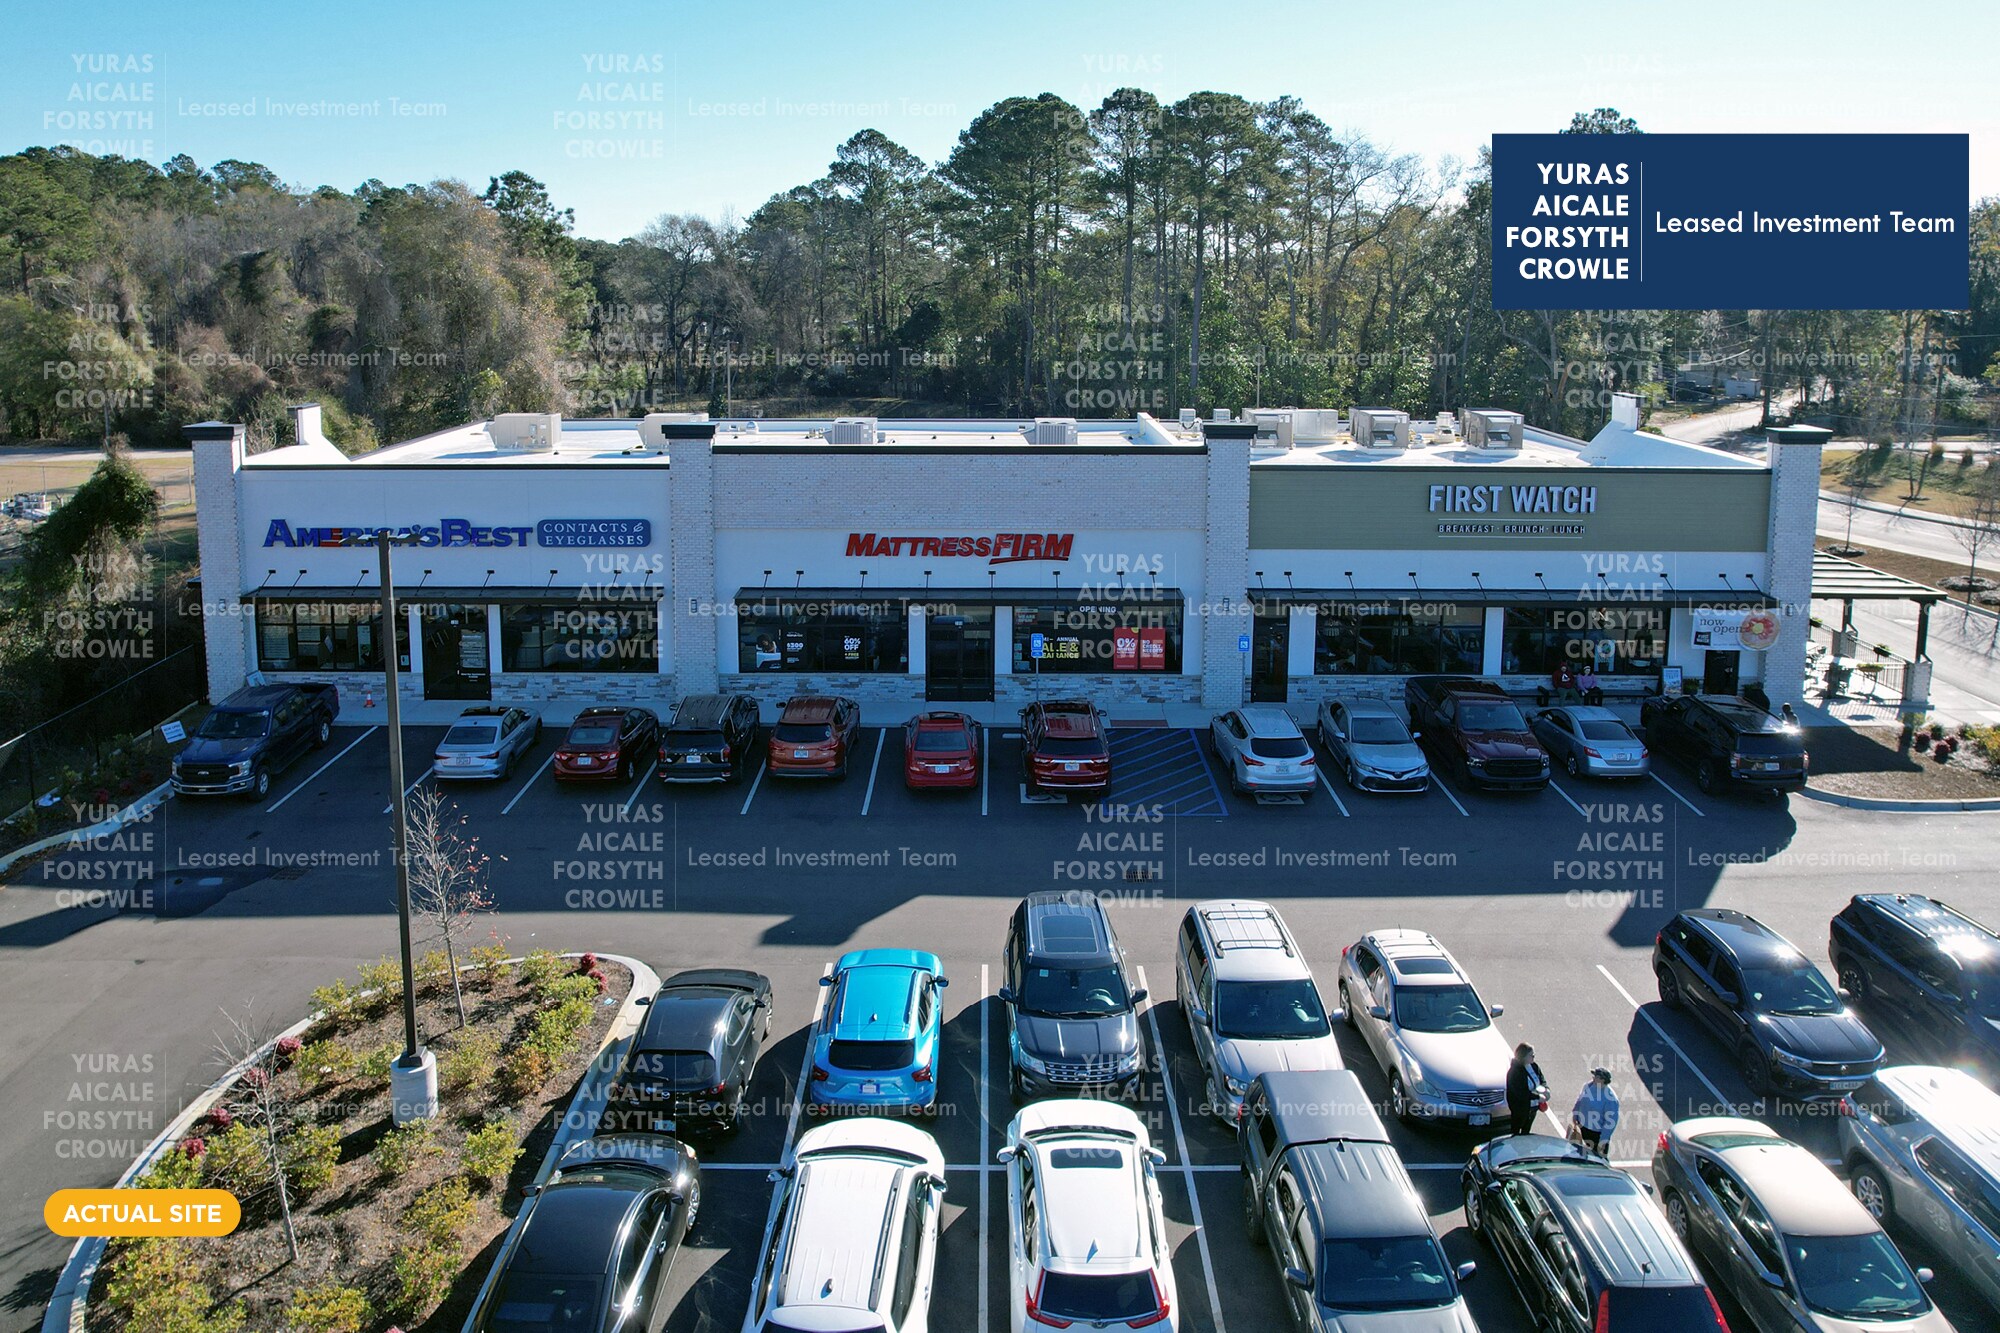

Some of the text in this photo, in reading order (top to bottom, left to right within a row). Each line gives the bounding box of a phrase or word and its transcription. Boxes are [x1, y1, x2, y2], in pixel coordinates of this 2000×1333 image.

[1428, 485, 1597, 514] FIRST WATCH
[543, 522, 628, 533] CONTACTS
[1438, 524, 1586, 534] BREAKFAST BRUNCH LUNCH
[545, 535, 644, 545] EYEGLASSES
[1079, 605, 1117, 613] OPENING
[1699, 618, 1725, 626] now
[1713, 625, 1742, 635] open
[843, 637, 861, 645] 60%
[1116, 637, 1136, 648] 0%
[1043, 642, 1079, 652] ALE &
